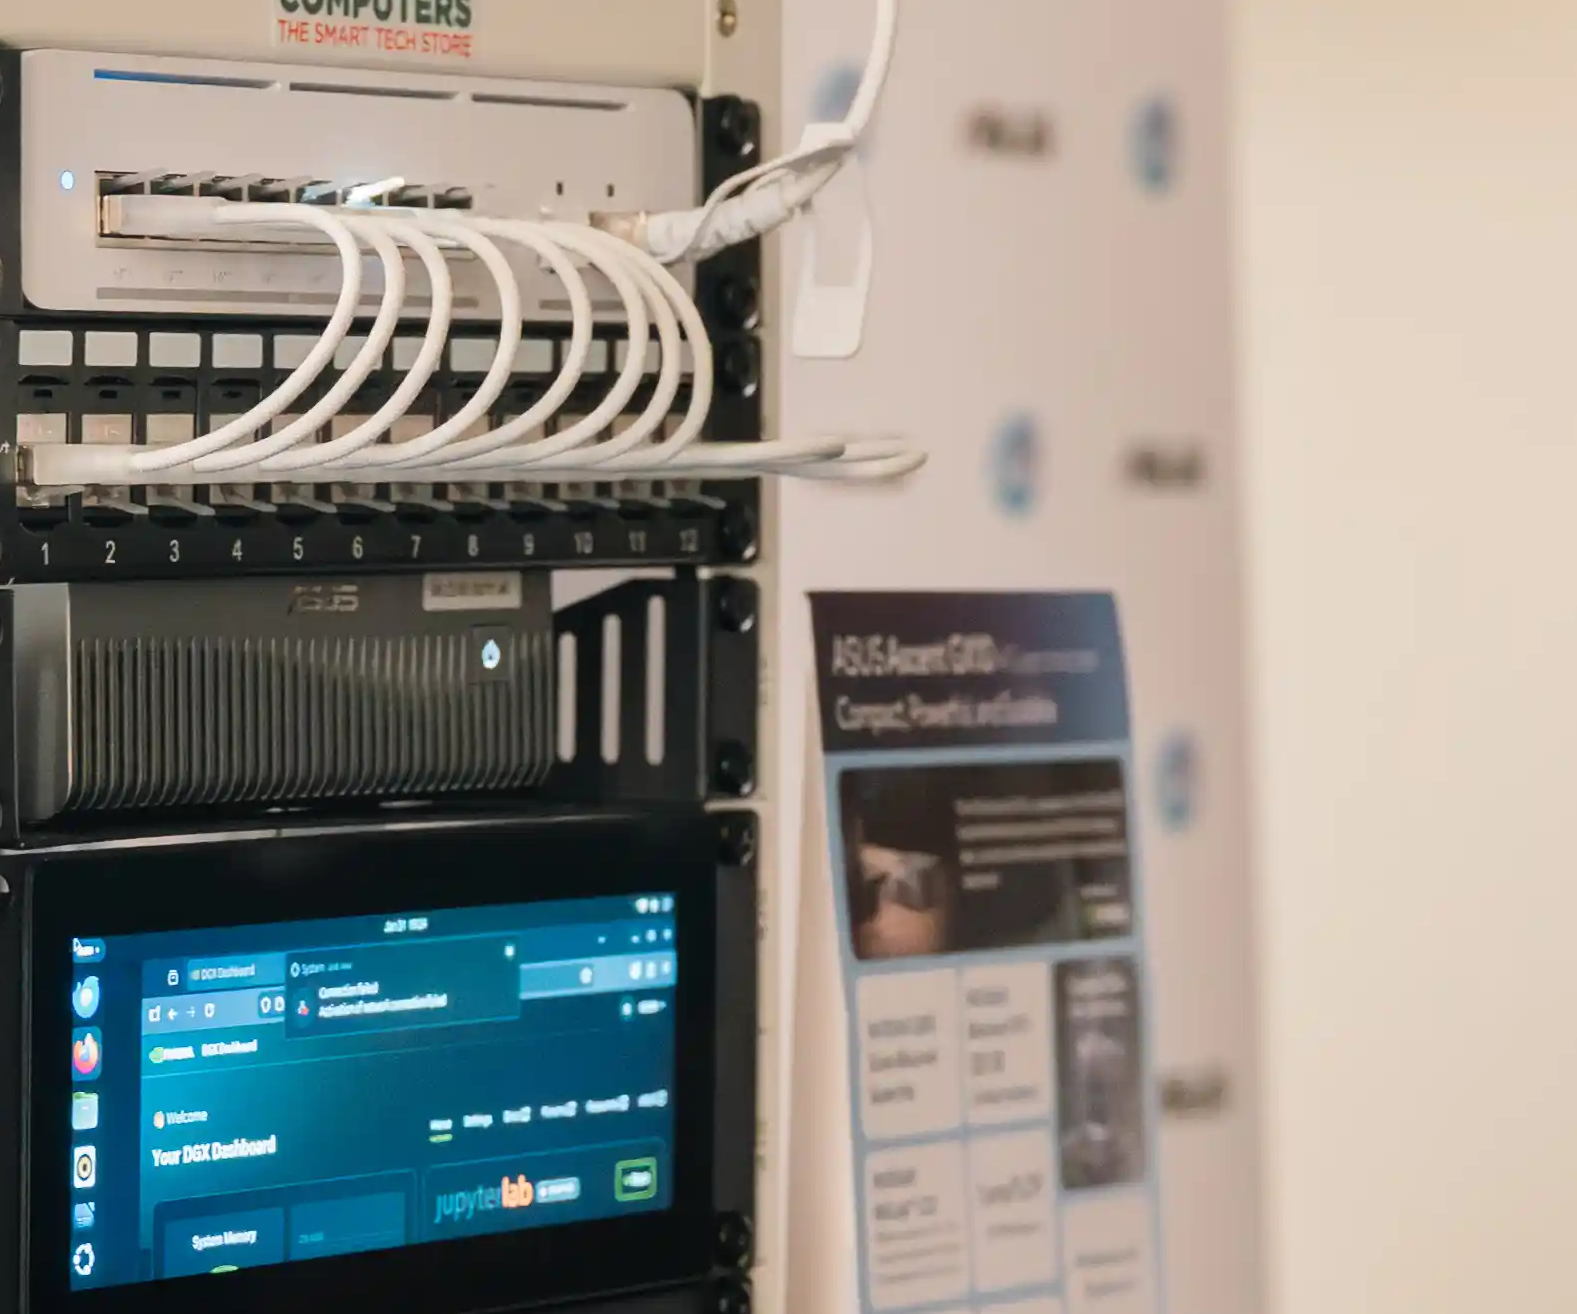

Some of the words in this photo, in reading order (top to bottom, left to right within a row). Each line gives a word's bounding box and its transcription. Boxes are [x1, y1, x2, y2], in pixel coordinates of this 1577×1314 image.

[278, 19, 310, 43] THE
[314, 22, 369, 47] SMART
[375, 27, 416, 51] TECH
[421, 31, 472, 58] STORE
[42, 543, 50, 565] 1
[105, 541, 116, 564] 2
[169, 539, 180, 562] 3
[232, 538, 243, 561] 4
[293, 537, 304, 559] 5
[352, 536, 363, 559] 6
[411, 535, 421, 558] 7
[468, 535, 479, 556] 8
[524, 534, 534, 555] 9
[574, 533, 593, 555] 10
[166, 1110, 208, 1125] Welcome
[152, 1148, 181, 1166] Your
[183, 1143, 211, 1163] DGX
[212, 1134, 277, 1160] Dashboard
[192, 1234, 223, 1251] System
[223, 1230, 258, 1245] Memory
